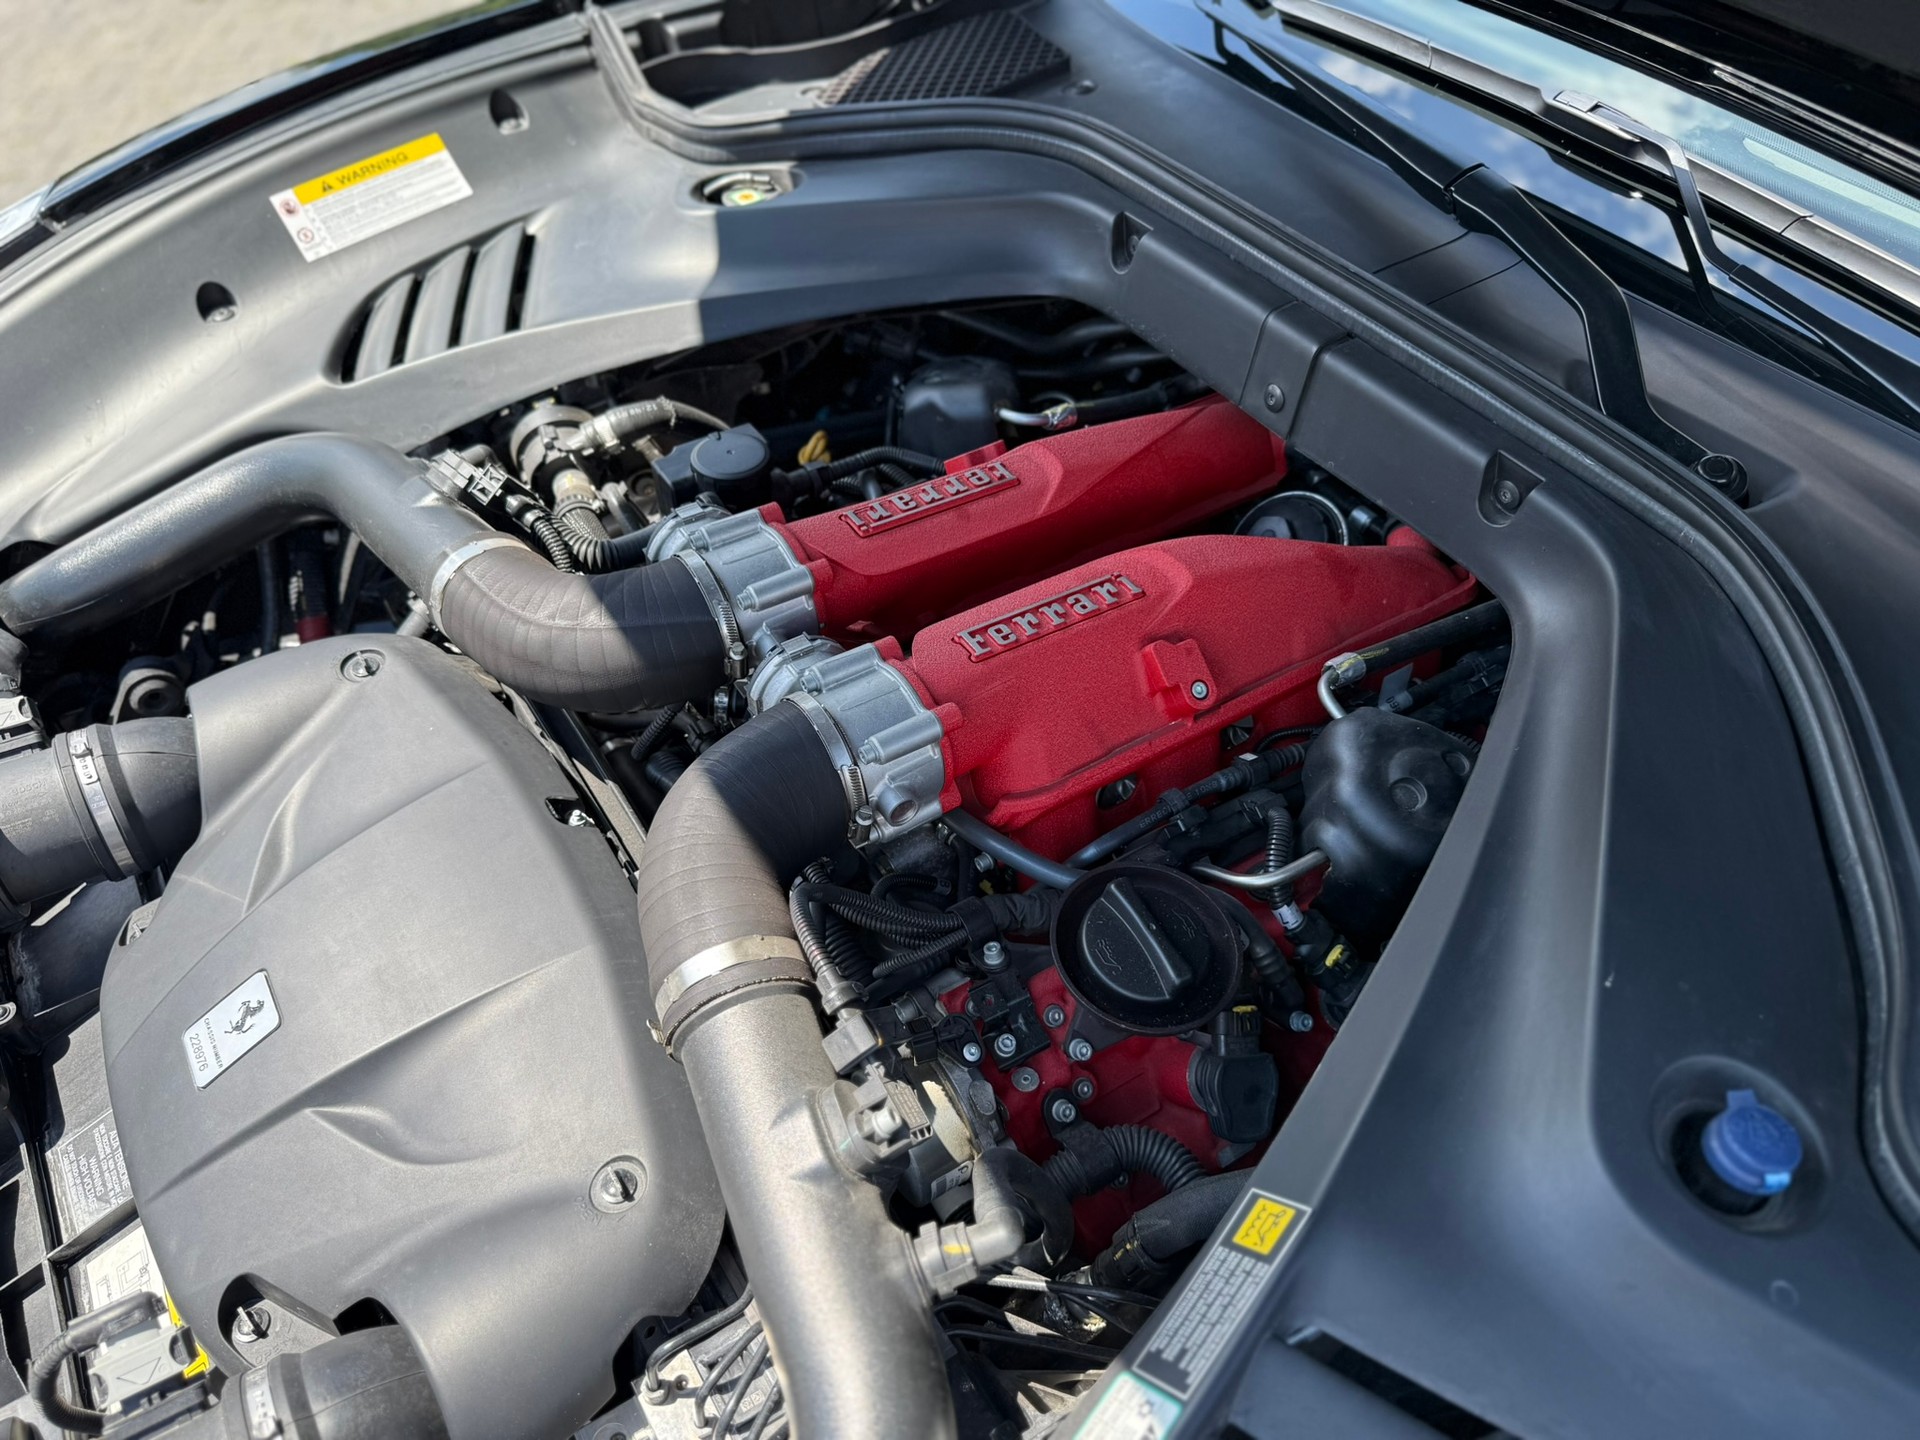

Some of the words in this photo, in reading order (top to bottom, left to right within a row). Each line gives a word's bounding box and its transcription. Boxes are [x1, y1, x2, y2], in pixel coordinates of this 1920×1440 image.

[337, 152, 408, 185] WARNING
[842, 461, 1018, 531] Ferrari
[955, 572, 1143, 656] Ferrari
[189, 1033, 209, 1072] 228976
[203, 1017, 216, 1044] CHASSIS
[212, 1044, 224, 1069] NUMBER
[78, 1153, 89, 1177] HIGH
[89, 1155, 105, 1196] WARNING
[108, 1130, 119, 1149] ALTA
[114, 1148, 130, 1190] TENSIONE
[83, 1174, 98, 1211] VOLTAGE
